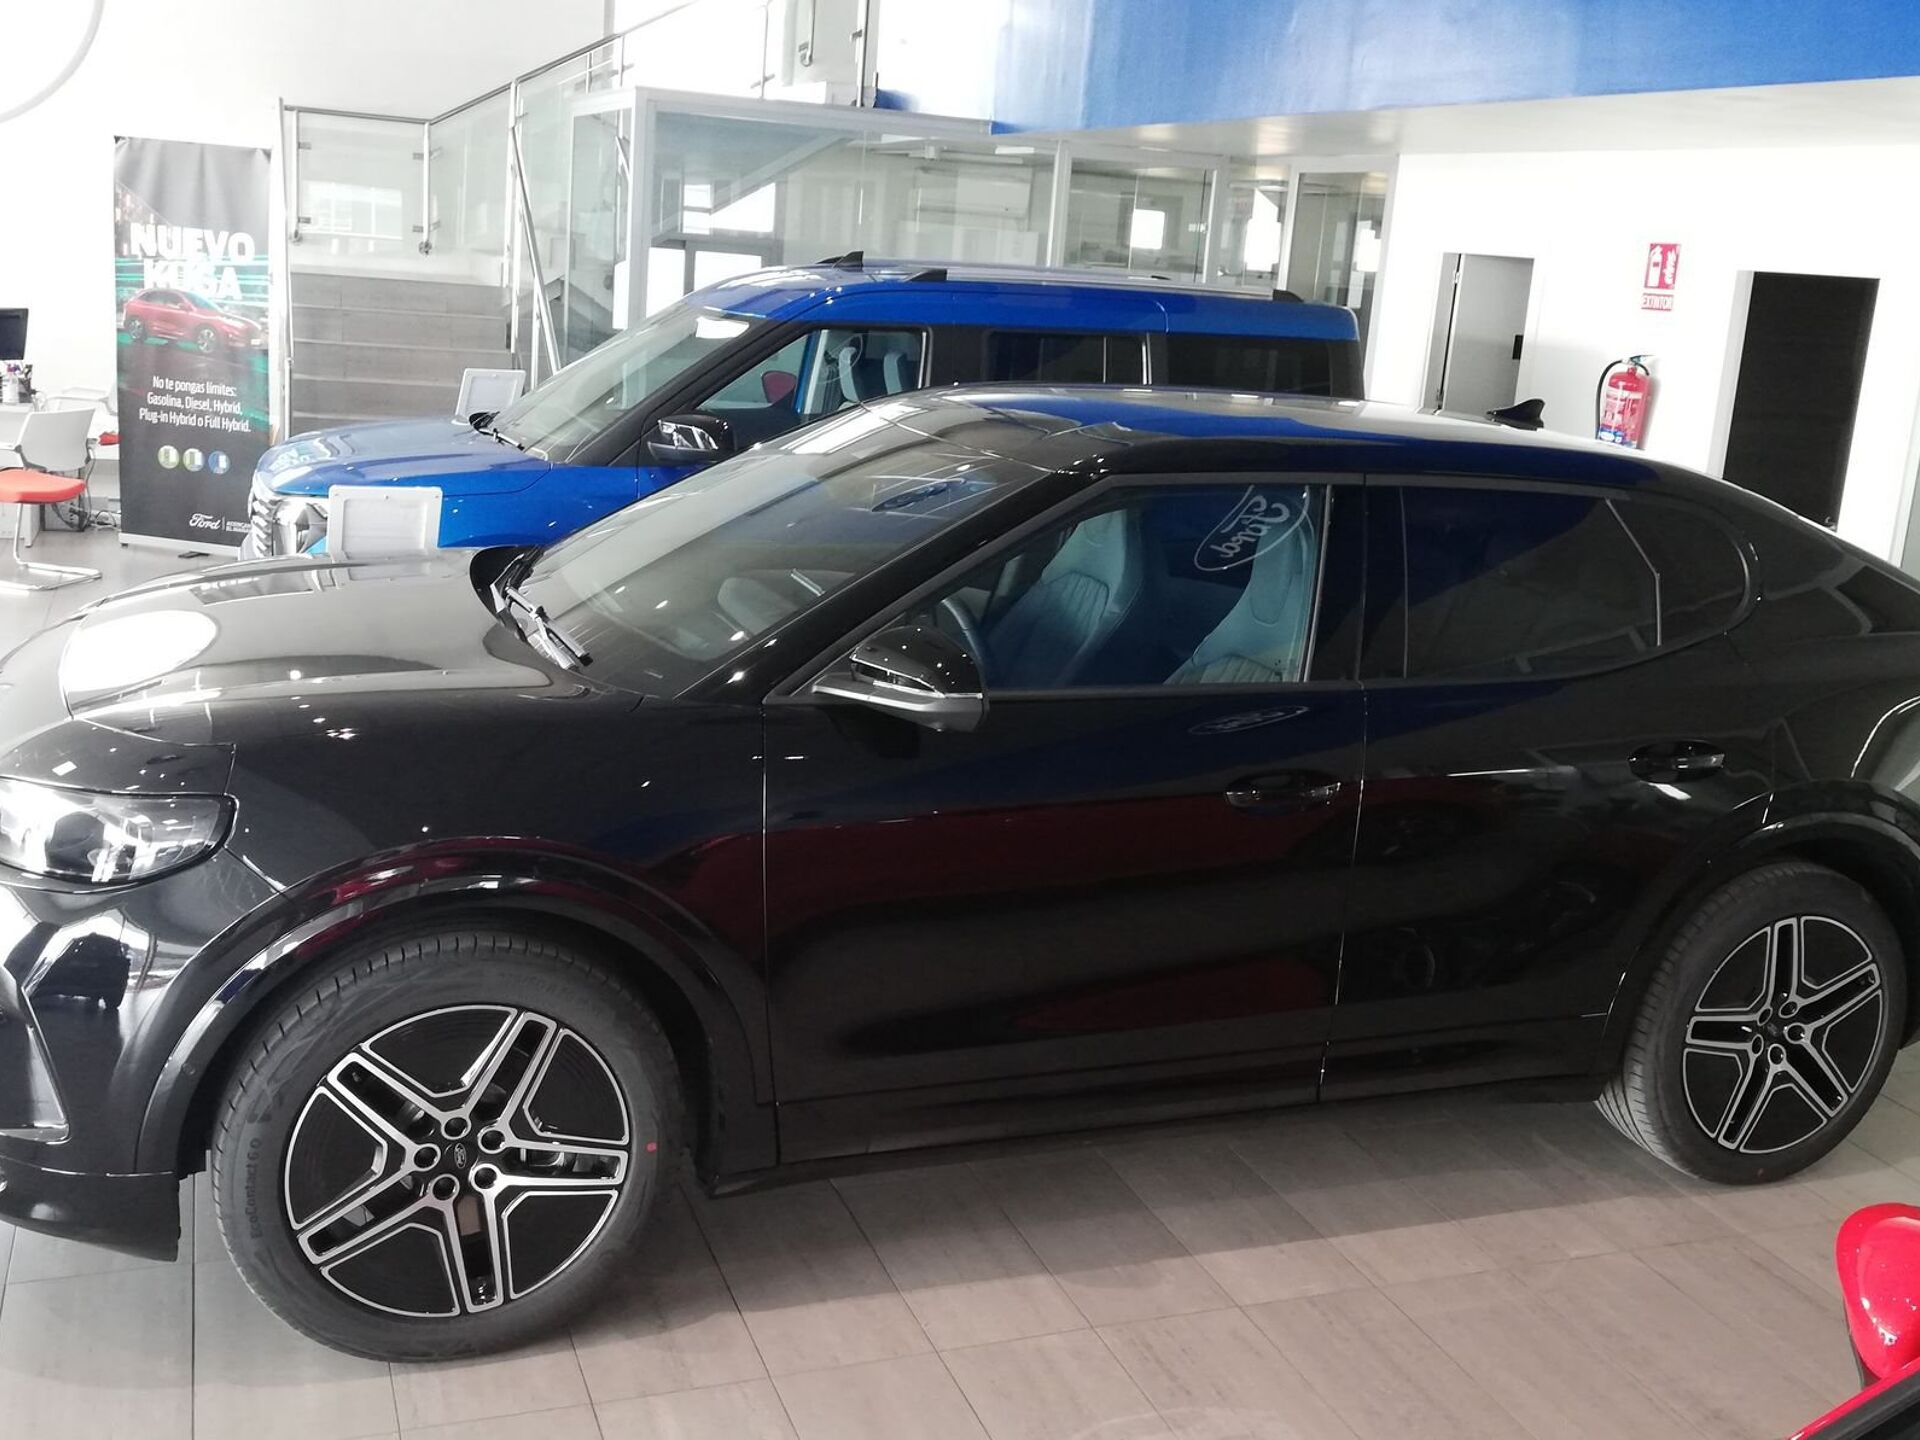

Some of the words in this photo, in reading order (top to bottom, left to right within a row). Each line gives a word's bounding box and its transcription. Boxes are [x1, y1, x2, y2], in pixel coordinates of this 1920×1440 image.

[130, 222, 255, 263] NUEVO
[153, 376, 164, 389] No
[165, 378, 174, 391] te
[175, 380, 205, 395] pongas
[147, 392, 184, 409] Gasolina,
[139, 408, 168, 424] Plug-in
[169, 411, 196, 427] Hybrid
[197, 417, 204, 427] o
[204, 415, 220, 429] Full
[221, 417, 251, 433] Hybrid.
[189, 513, 221, 530] Ford
[244, 1163, 263, 1239] EcoContact
